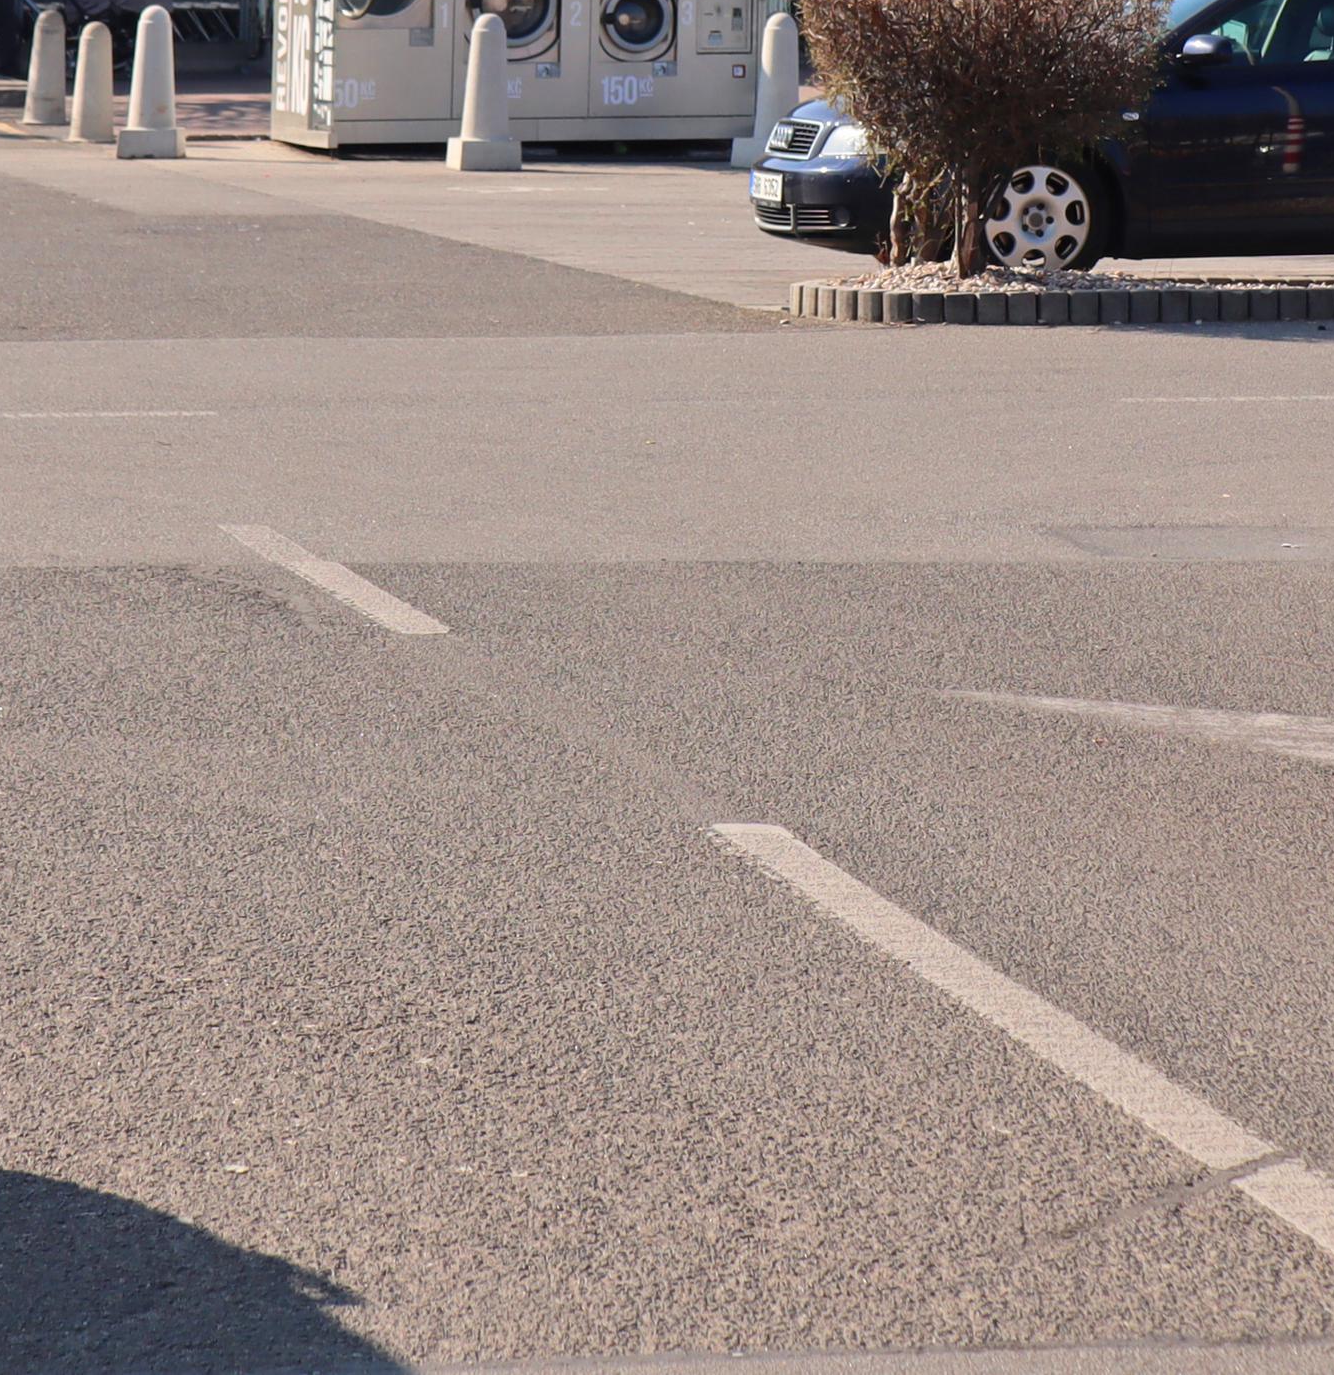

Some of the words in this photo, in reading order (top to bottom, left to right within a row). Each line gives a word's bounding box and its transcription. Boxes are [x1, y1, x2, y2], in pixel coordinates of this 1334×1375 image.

[440, 4, 448, 27] 1
[570, 2, 582, 27] 2
[682, 0, 694, 25] 3
[601, 76, 638, 106] 150
